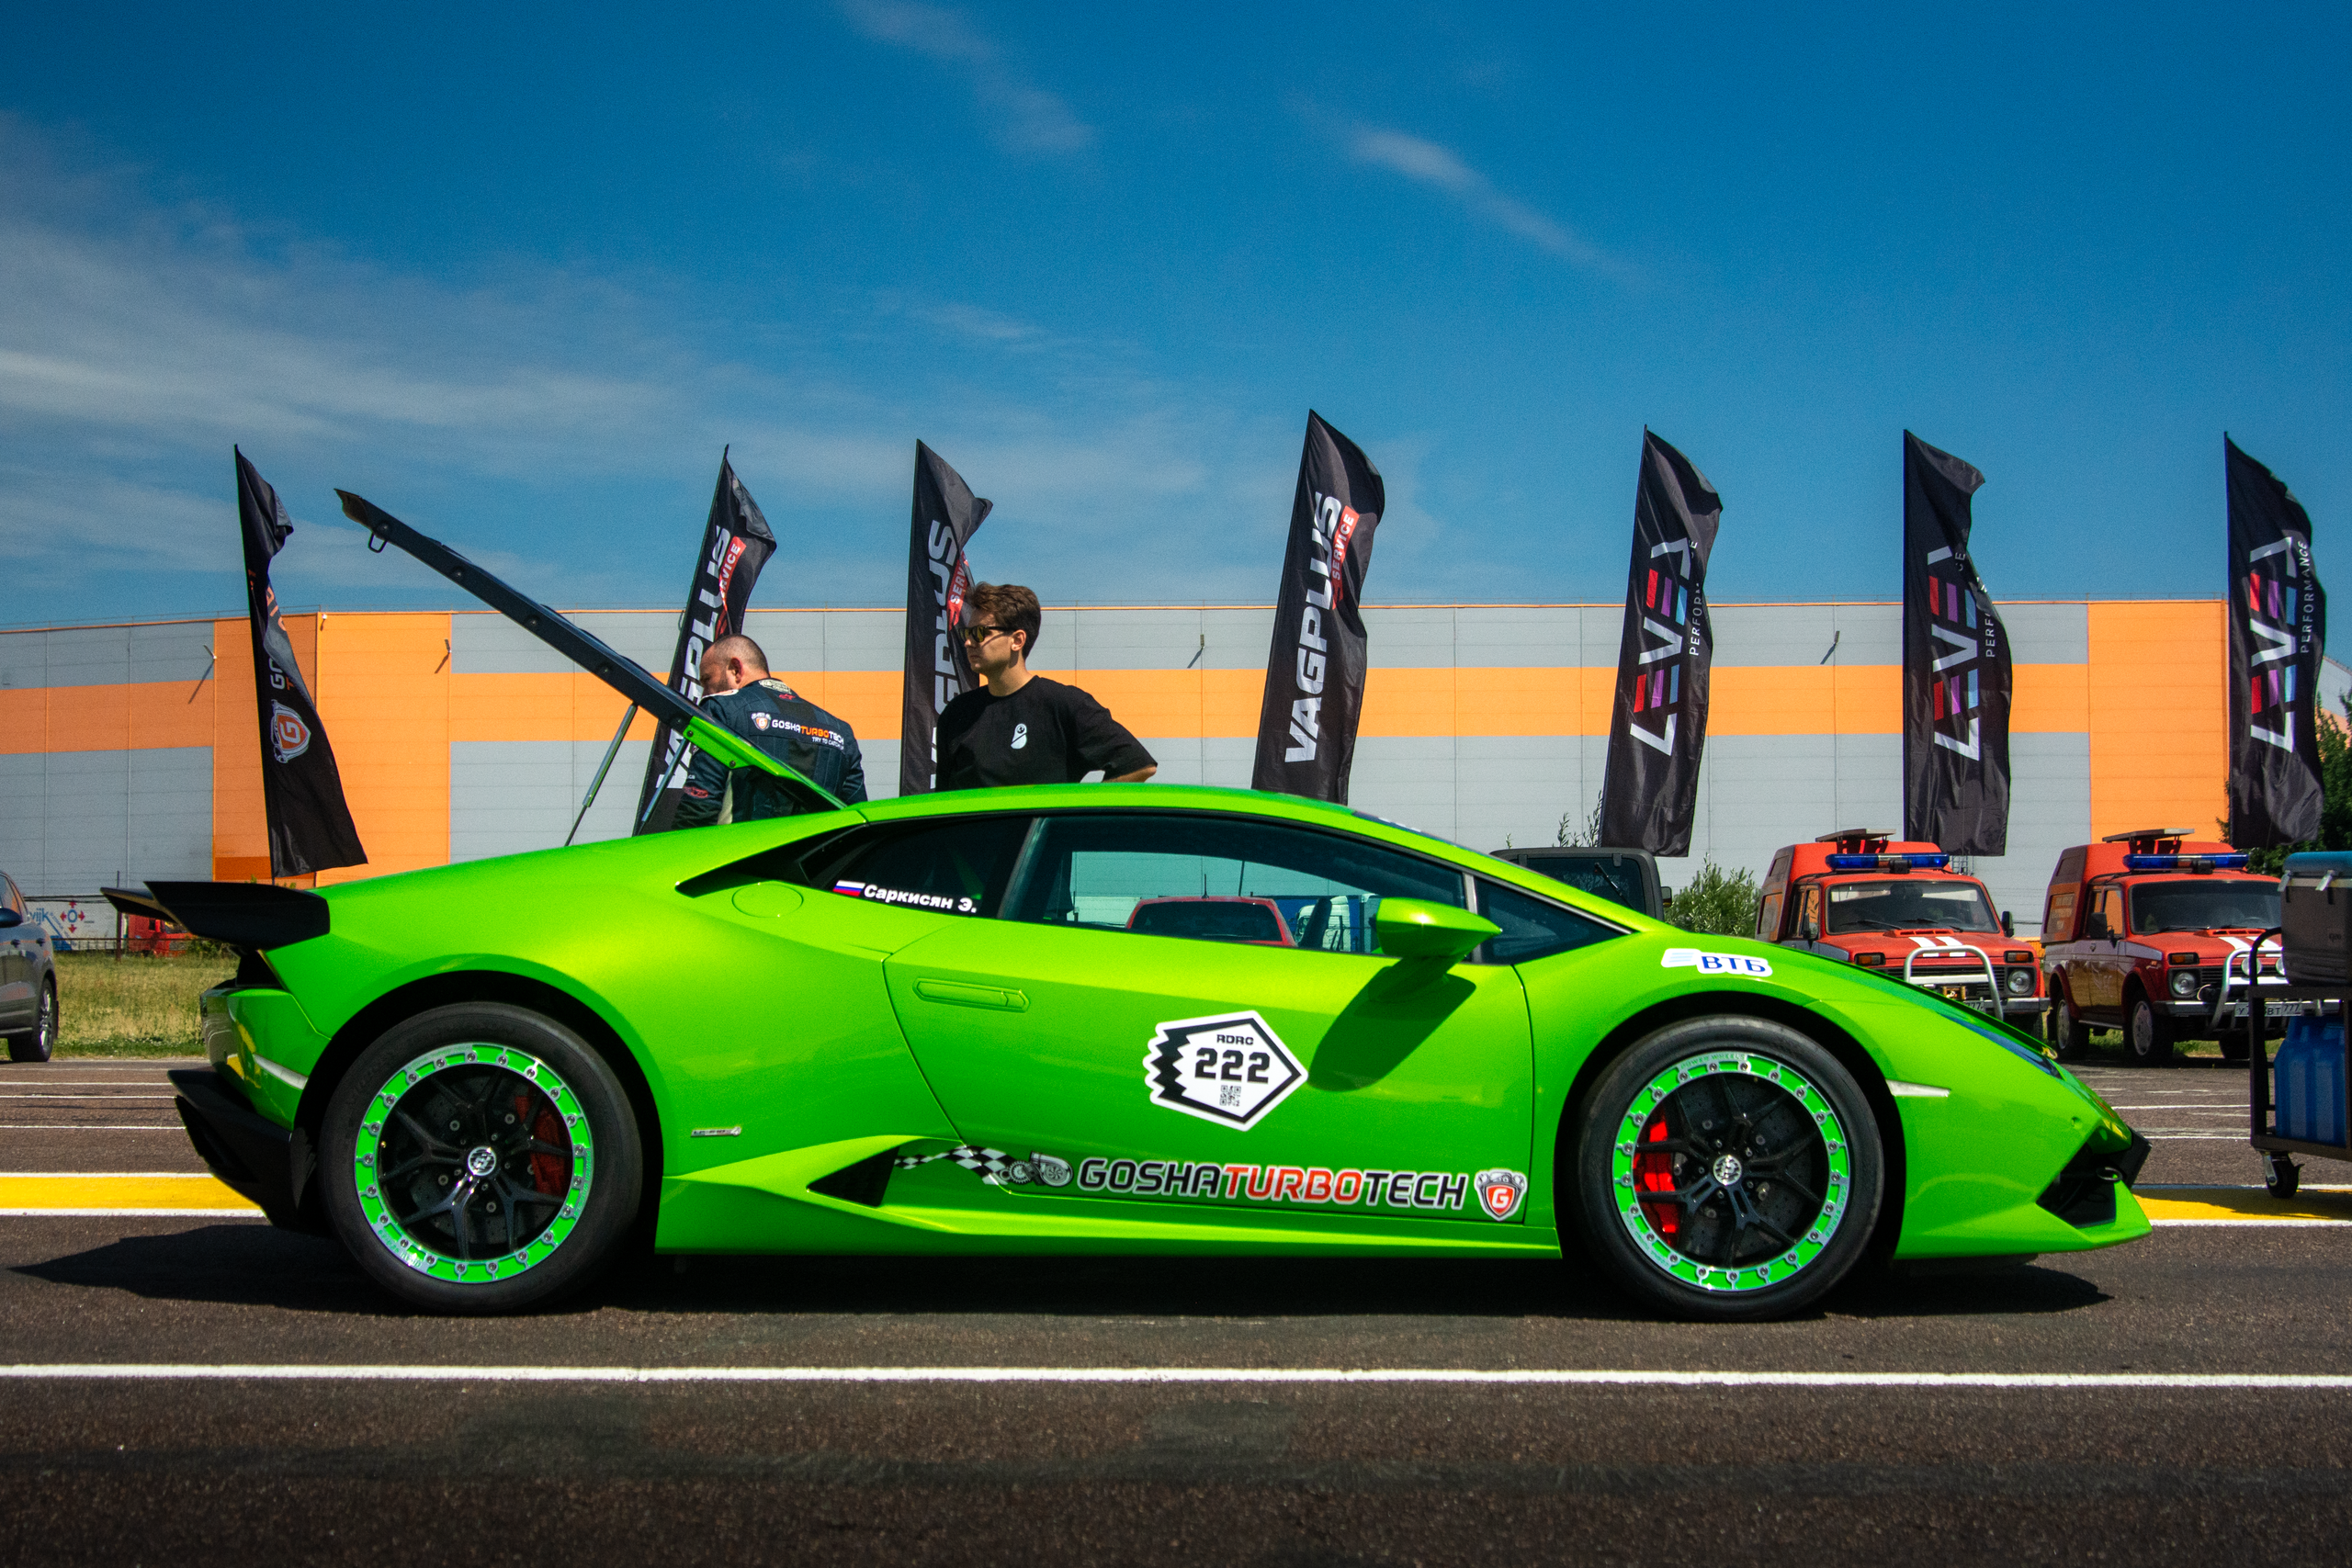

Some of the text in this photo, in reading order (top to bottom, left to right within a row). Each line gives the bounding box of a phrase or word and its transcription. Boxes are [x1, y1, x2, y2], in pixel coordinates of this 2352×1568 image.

[1332, 513, 1354, 581] SERVICE
[2300, 540, 2315, 654] PERFORMANCE
[1284, 491, 1341, 762] VAGPLUS
[864, 884, 977, 913] Саркисян Э.
[1701, 955, 1766, 973] ВТБ
[1216, 1034, 1254, 1045] RDRC
[1194, 1047, 1271, 1084] 222
[1079, 1157, 1468, 1210] GOSHATURBOTECH
[1491, 1189, 1510, 1209] G
